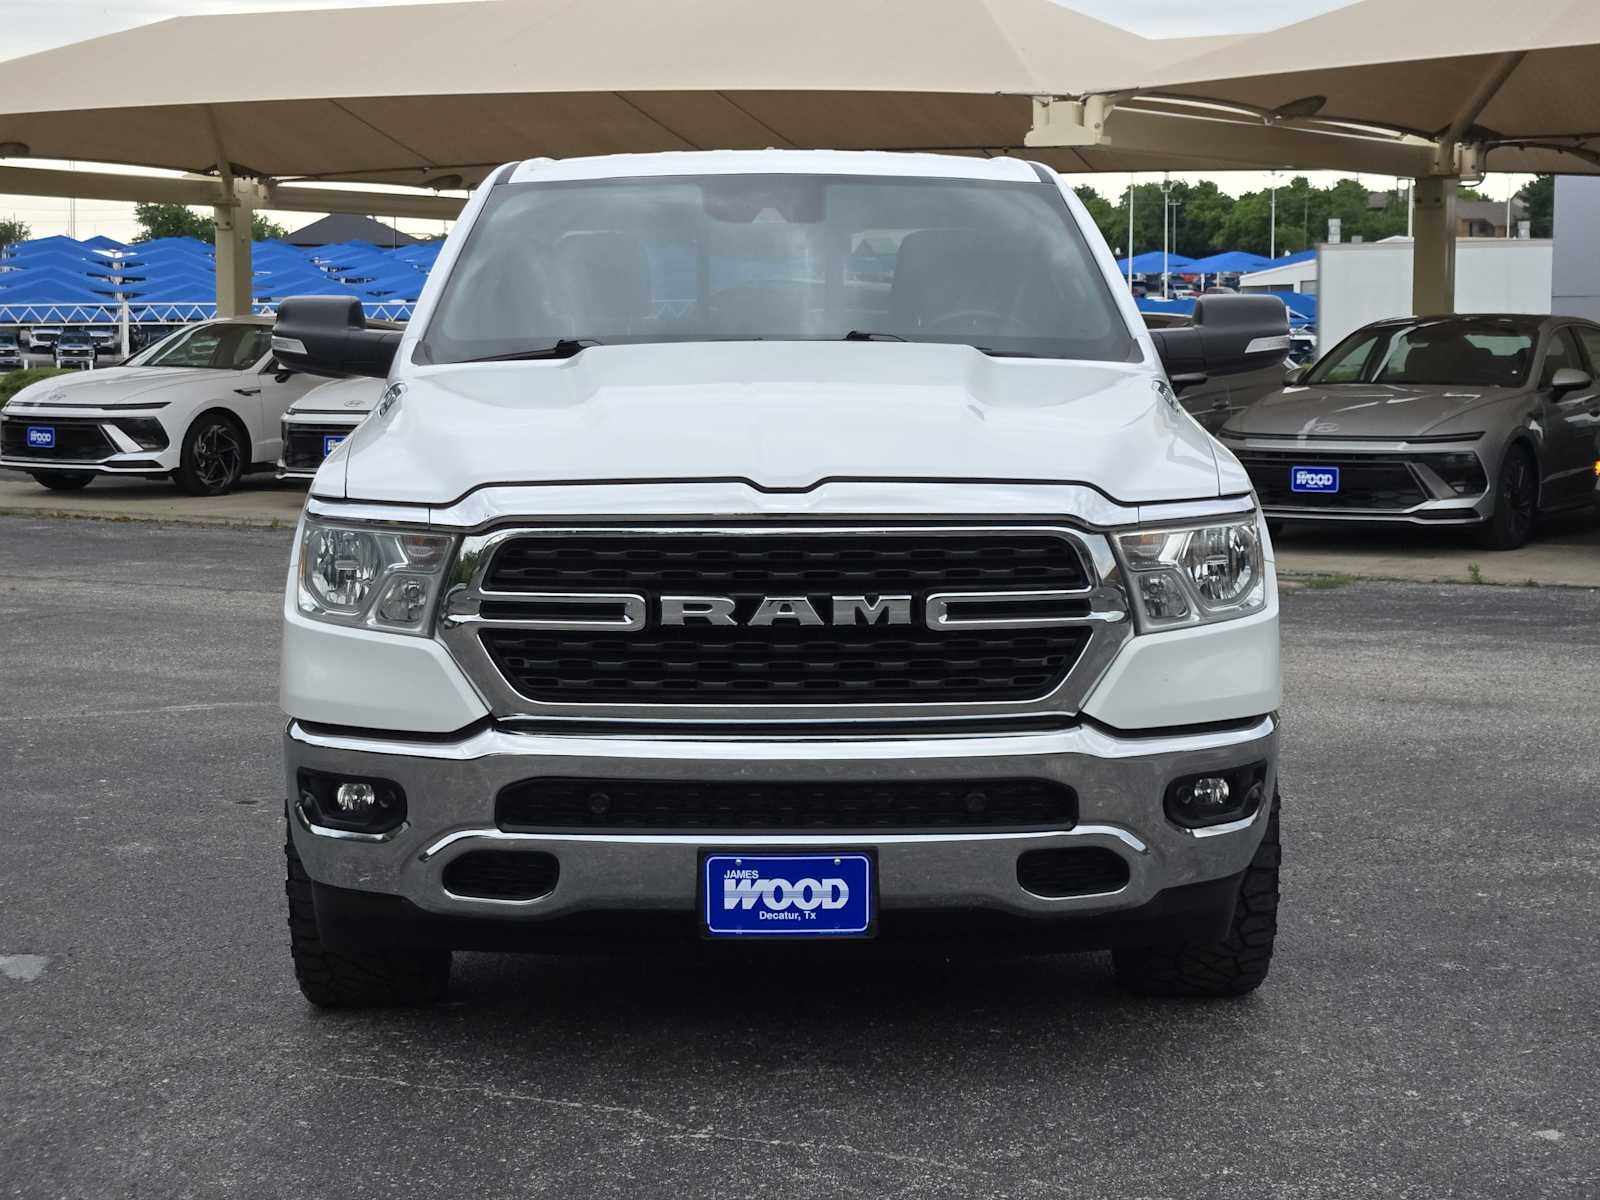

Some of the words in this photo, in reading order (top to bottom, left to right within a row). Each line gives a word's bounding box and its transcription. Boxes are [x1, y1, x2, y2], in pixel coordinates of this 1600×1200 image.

[1296, 473, 1333, 485] WOOD
[660, 594, 912, 626] RAM
[724, 870, 759, 879] JAMES
[724, 878, 849, 910] WOOD
[759, 911, 801, 920] Decatur,
[803, 911, 816, 920] Tx
